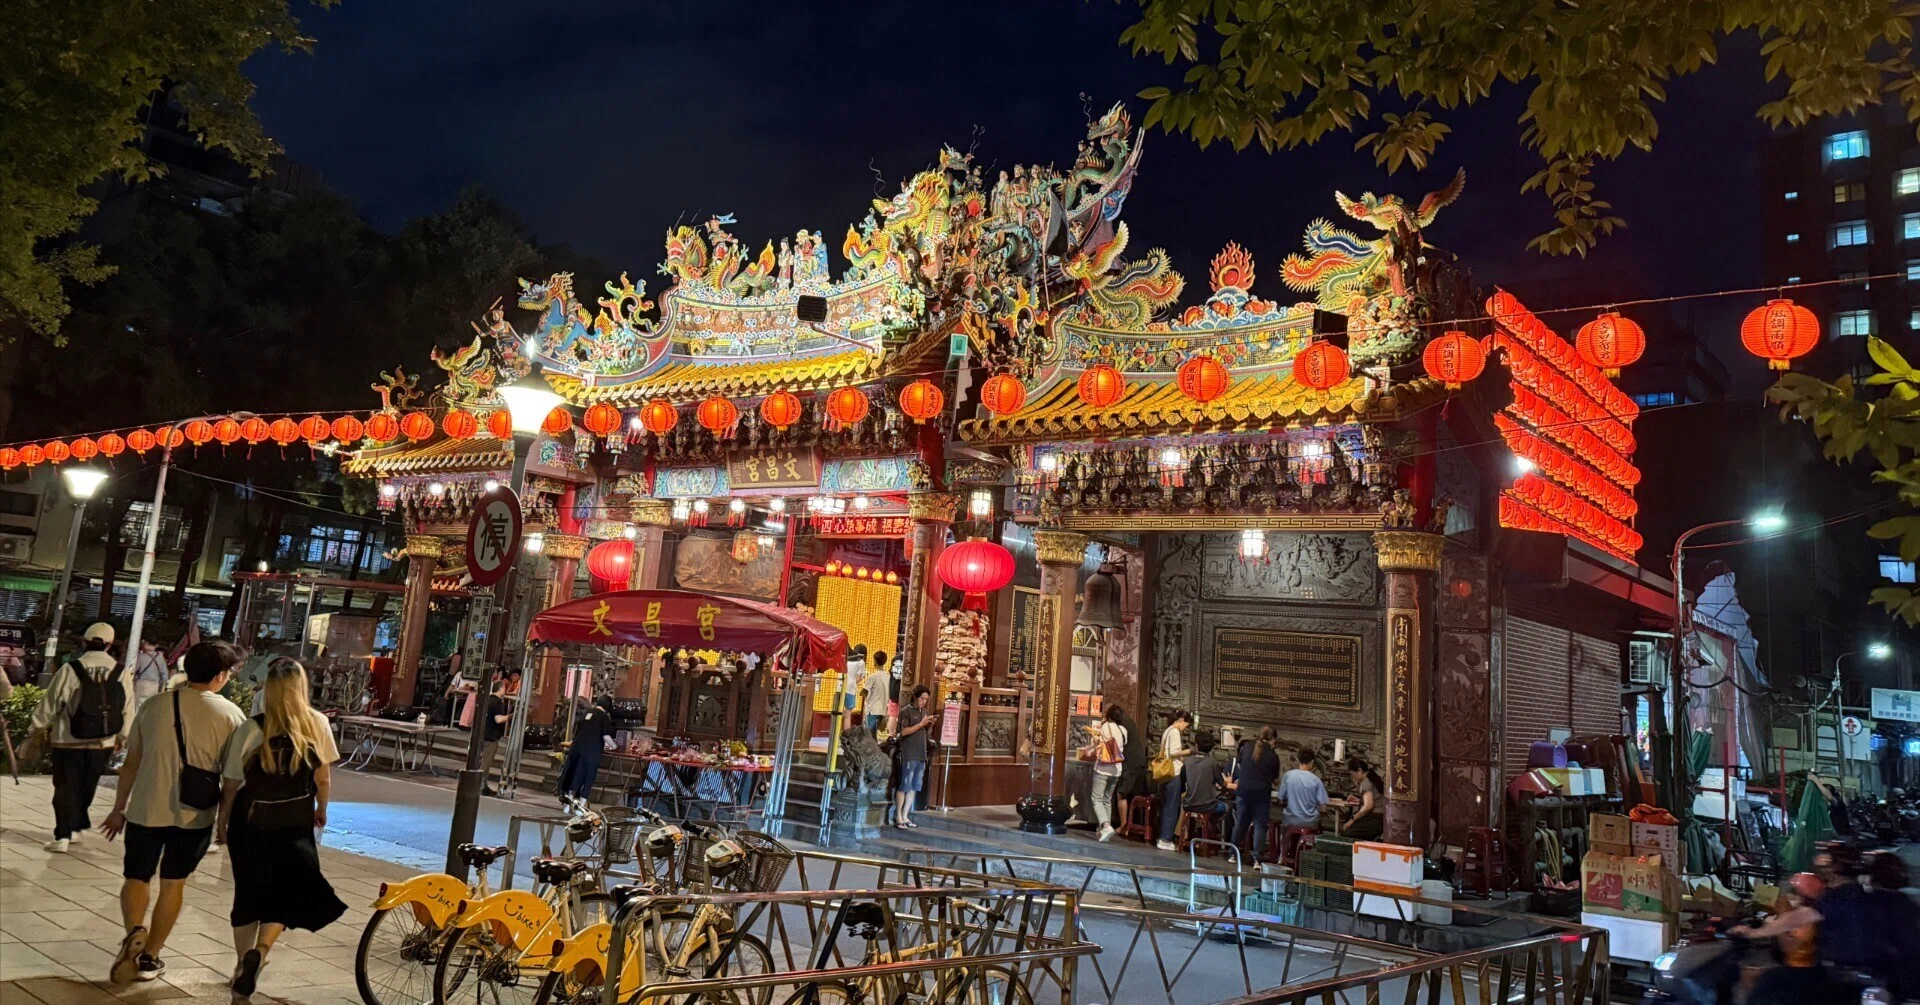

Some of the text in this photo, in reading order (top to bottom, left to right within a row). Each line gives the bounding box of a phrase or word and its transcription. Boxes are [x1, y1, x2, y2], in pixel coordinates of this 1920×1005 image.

[1770, 309, 1786, 350] 風調雨順
[745, 452, 801, 482] 文昌宮
[480, 512, 509, 561] 停
[588, 599, 721, 641] 文昌宮
